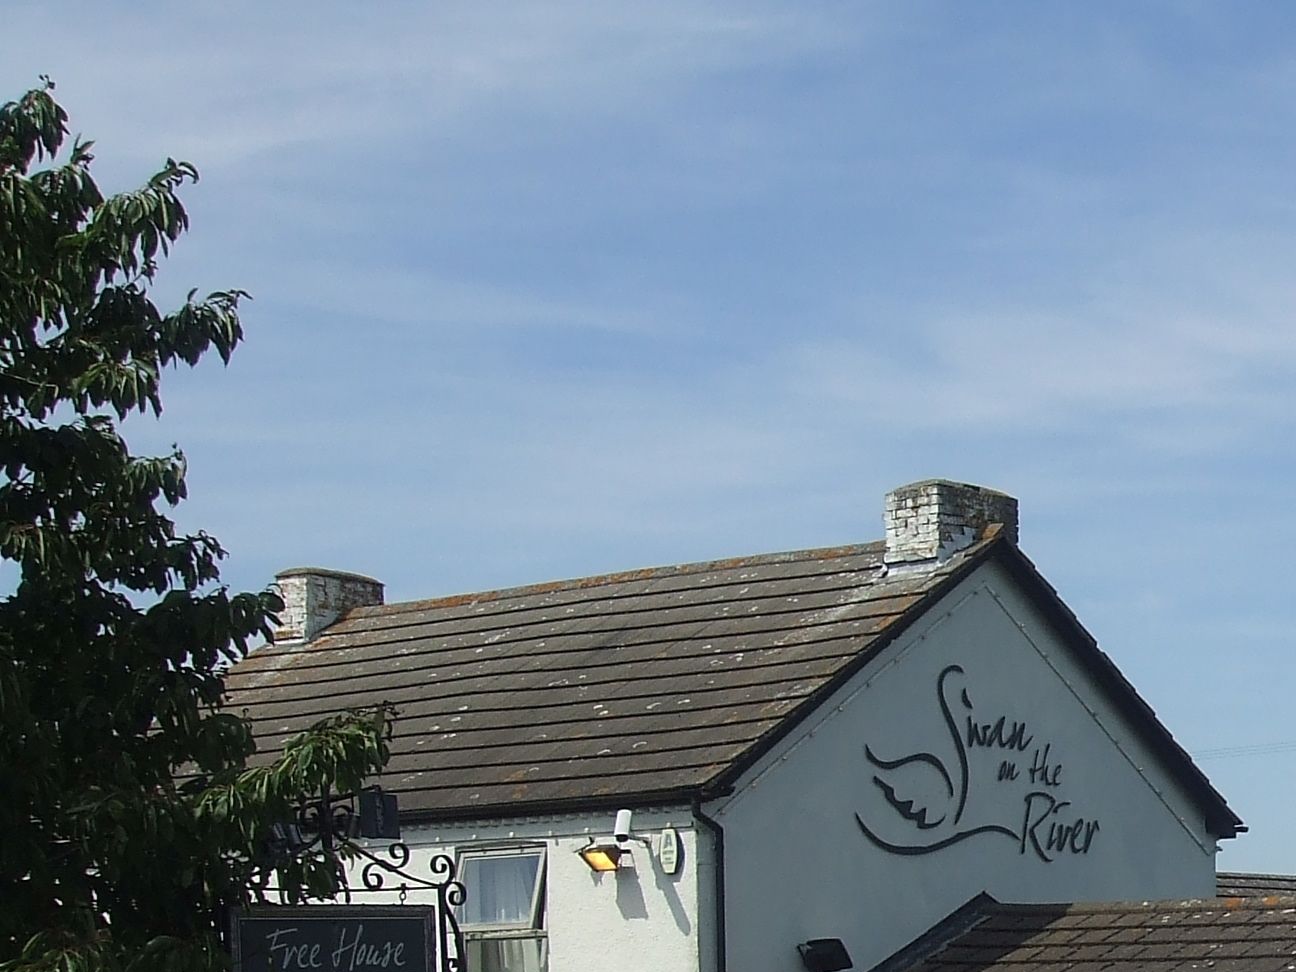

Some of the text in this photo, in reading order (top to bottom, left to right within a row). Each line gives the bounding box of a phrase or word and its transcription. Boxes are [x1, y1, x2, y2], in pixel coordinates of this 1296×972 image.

[998, 744, 1062, 786] on the
[1020, 792, 1100, 862] River
[265, 926, 406, 971] Free House
